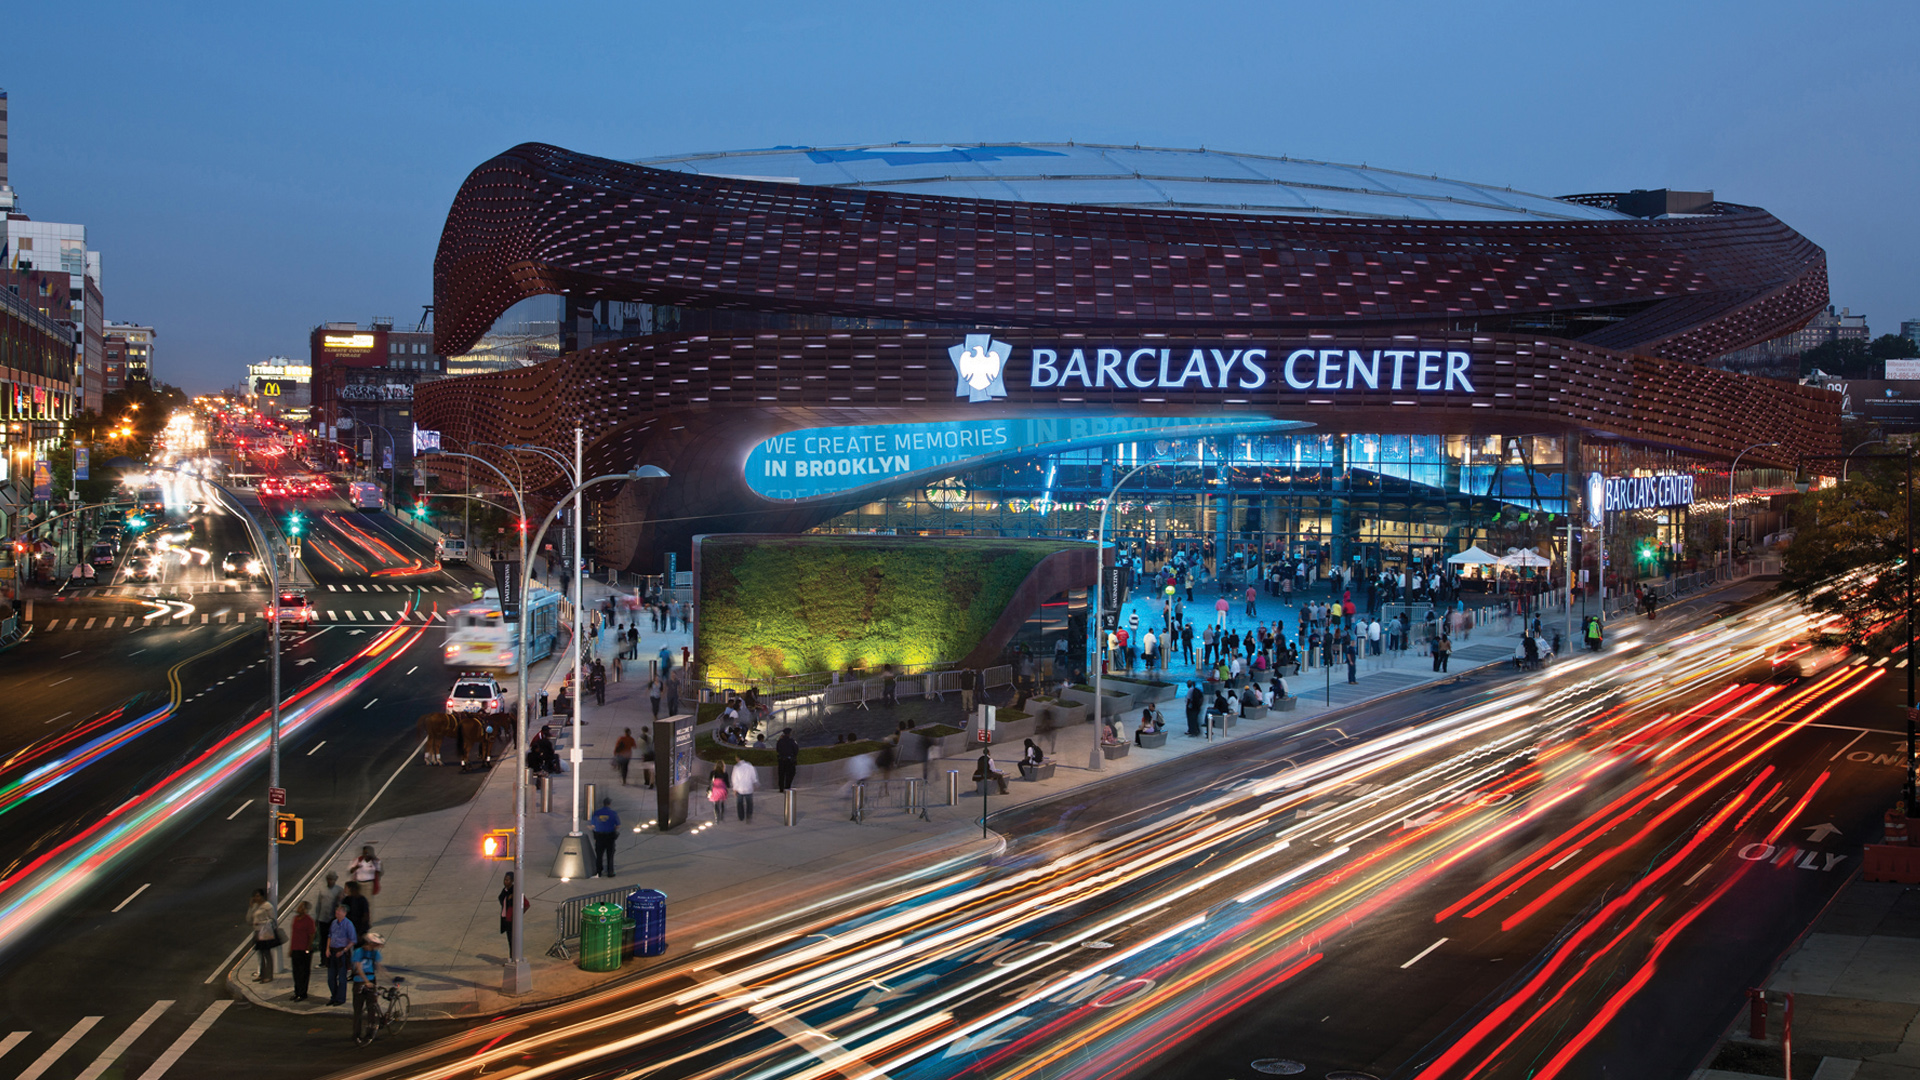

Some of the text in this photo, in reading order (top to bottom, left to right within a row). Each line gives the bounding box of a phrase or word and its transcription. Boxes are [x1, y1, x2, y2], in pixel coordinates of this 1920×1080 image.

[1031, 347, 1475, 392] BARCLAYS CENTER
[765, 427, 1007, 454] WE CREATE MEMORIES
[1026, 419, 1058, 444] IN
[765, 455, 910, 477] IN BROOKLYN
[1605, 475, 1694, 511] BARCLAYS CENTER
[1846, 751, 1908, 768] ONL
[1738, 842, 1848, 872] ONLY
